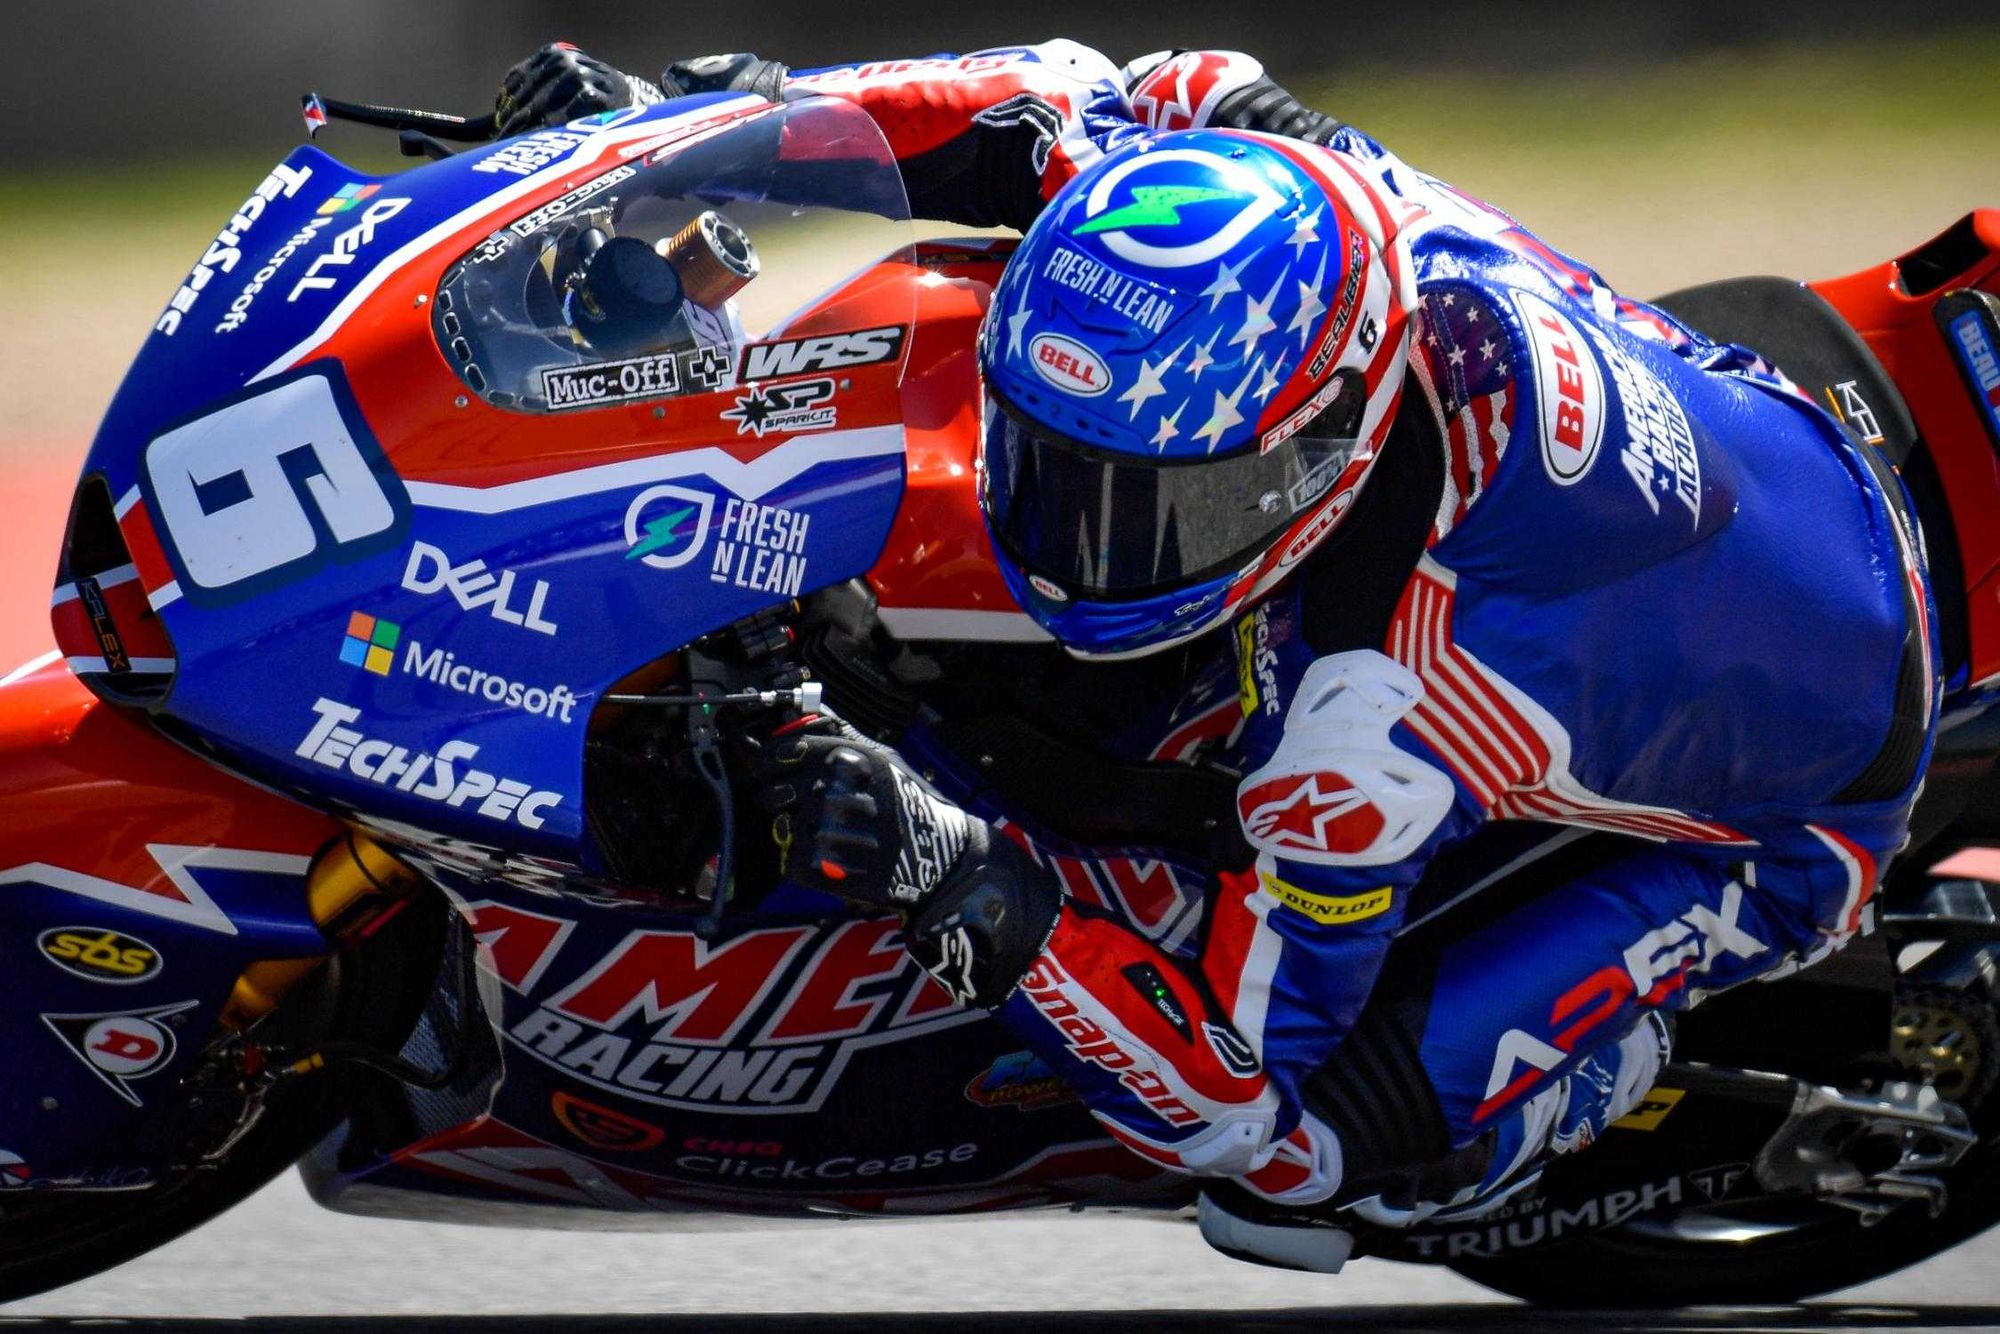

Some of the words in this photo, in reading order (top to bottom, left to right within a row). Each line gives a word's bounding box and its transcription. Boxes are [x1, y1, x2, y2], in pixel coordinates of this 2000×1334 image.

[215, 217, 333, 334] Microsoft
[287, 197, 413, 302] DELL
[1043, 247, 1105, 297] FRESH
[1099, 270, 1123, 304] N
[1112, 281, 1174, 334] LEAN
[745, 327, 900, 379] WRS
[1358, 310, 1378, 355] 6
[550, 359, 671, 404] Muc-Off
[1039, 343, 1095, 386] BELL
[1538, 313, 1585, 452] BELL
[766, 380, 834, 412] SP
[146, 374, 395, 589] 6
[720, 498, 810, 554] FRESH
[1290, 504, 1346, 558] BELL
[401, 540, 557, 636] DELL
[711, 540, 735, 583] N
[735, 546, 807, 597] LEAN
[1034, 580, 1061, 598] BELL
[403, 641, 577, 723] Microsoft
[1286, 893, 1385, 916] DUNLOP
[46, 932, 154, 976] sbs
[511, 1010, 823, 1105] RACING
[675, 1142, 979, 1179] ClickCease
[1405, 1176, 1682, 1258] TRIUMPH
